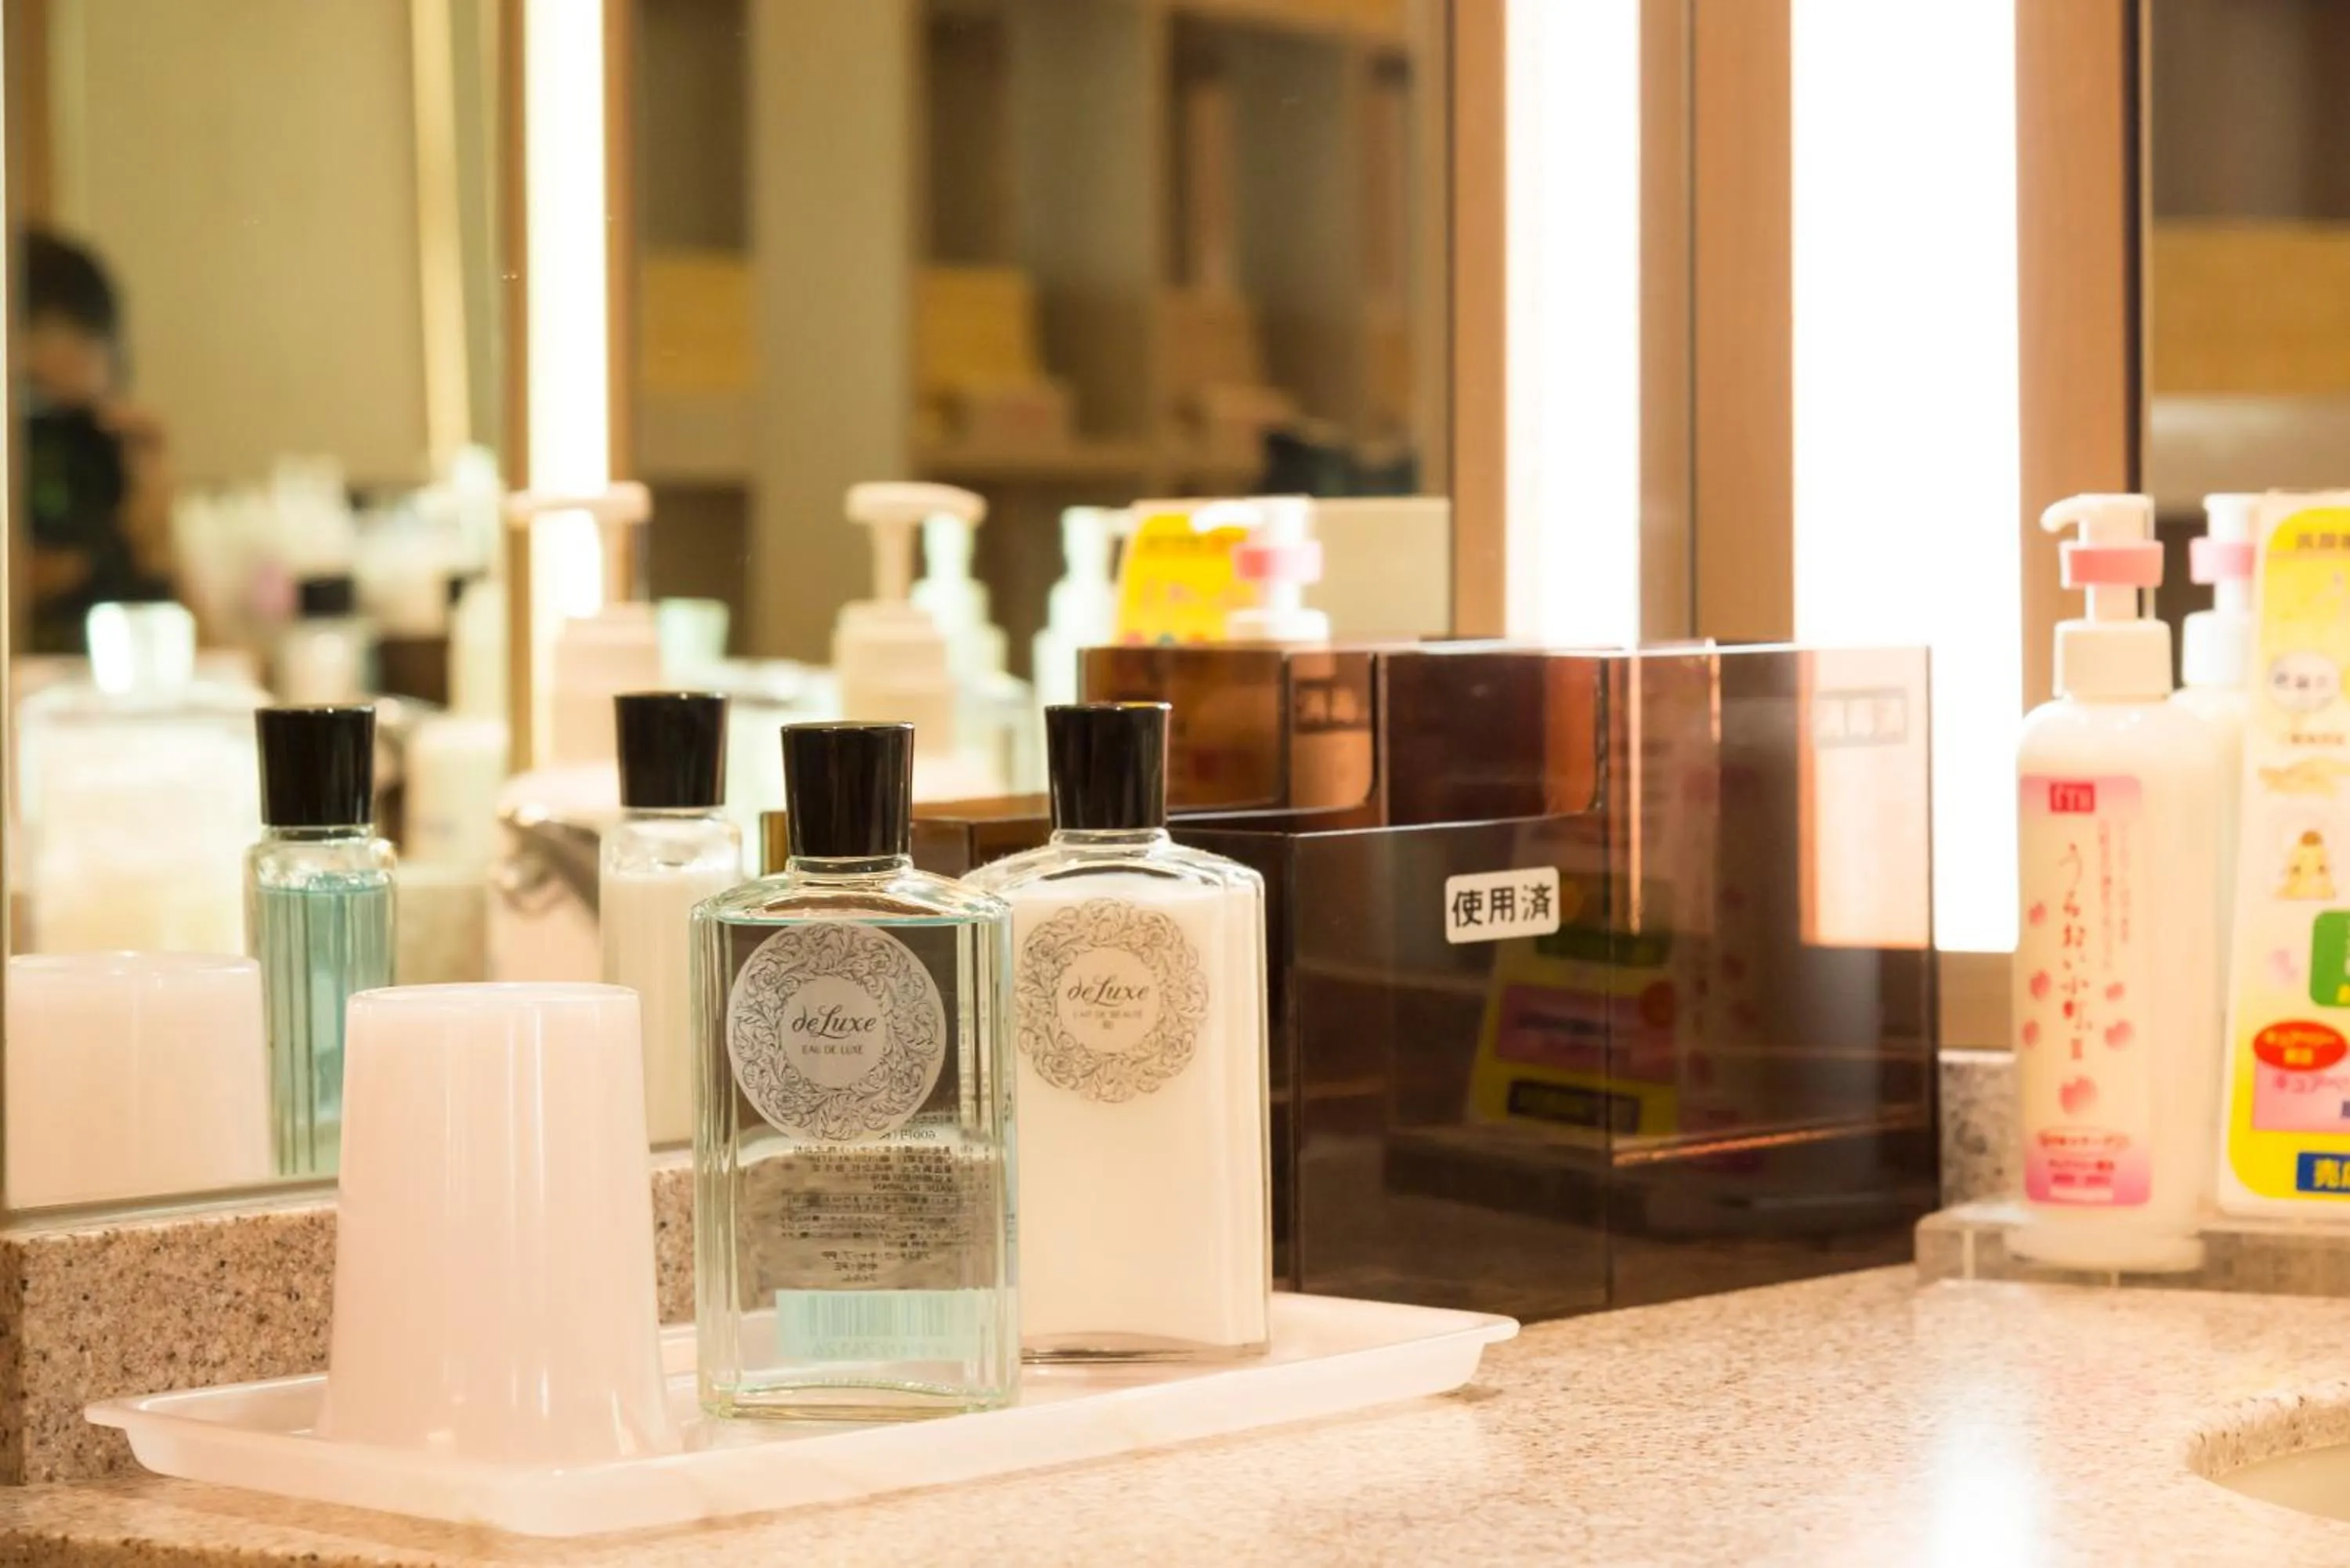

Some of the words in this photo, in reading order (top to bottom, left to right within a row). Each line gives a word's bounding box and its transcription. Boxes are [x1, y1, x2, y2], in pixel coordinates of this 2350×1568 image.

[1452, 883, 1553, 928] 使用済
[1066, 974, 1150, 1007] deLuxe
[792, 1004, 877, 1039] deLuxe
